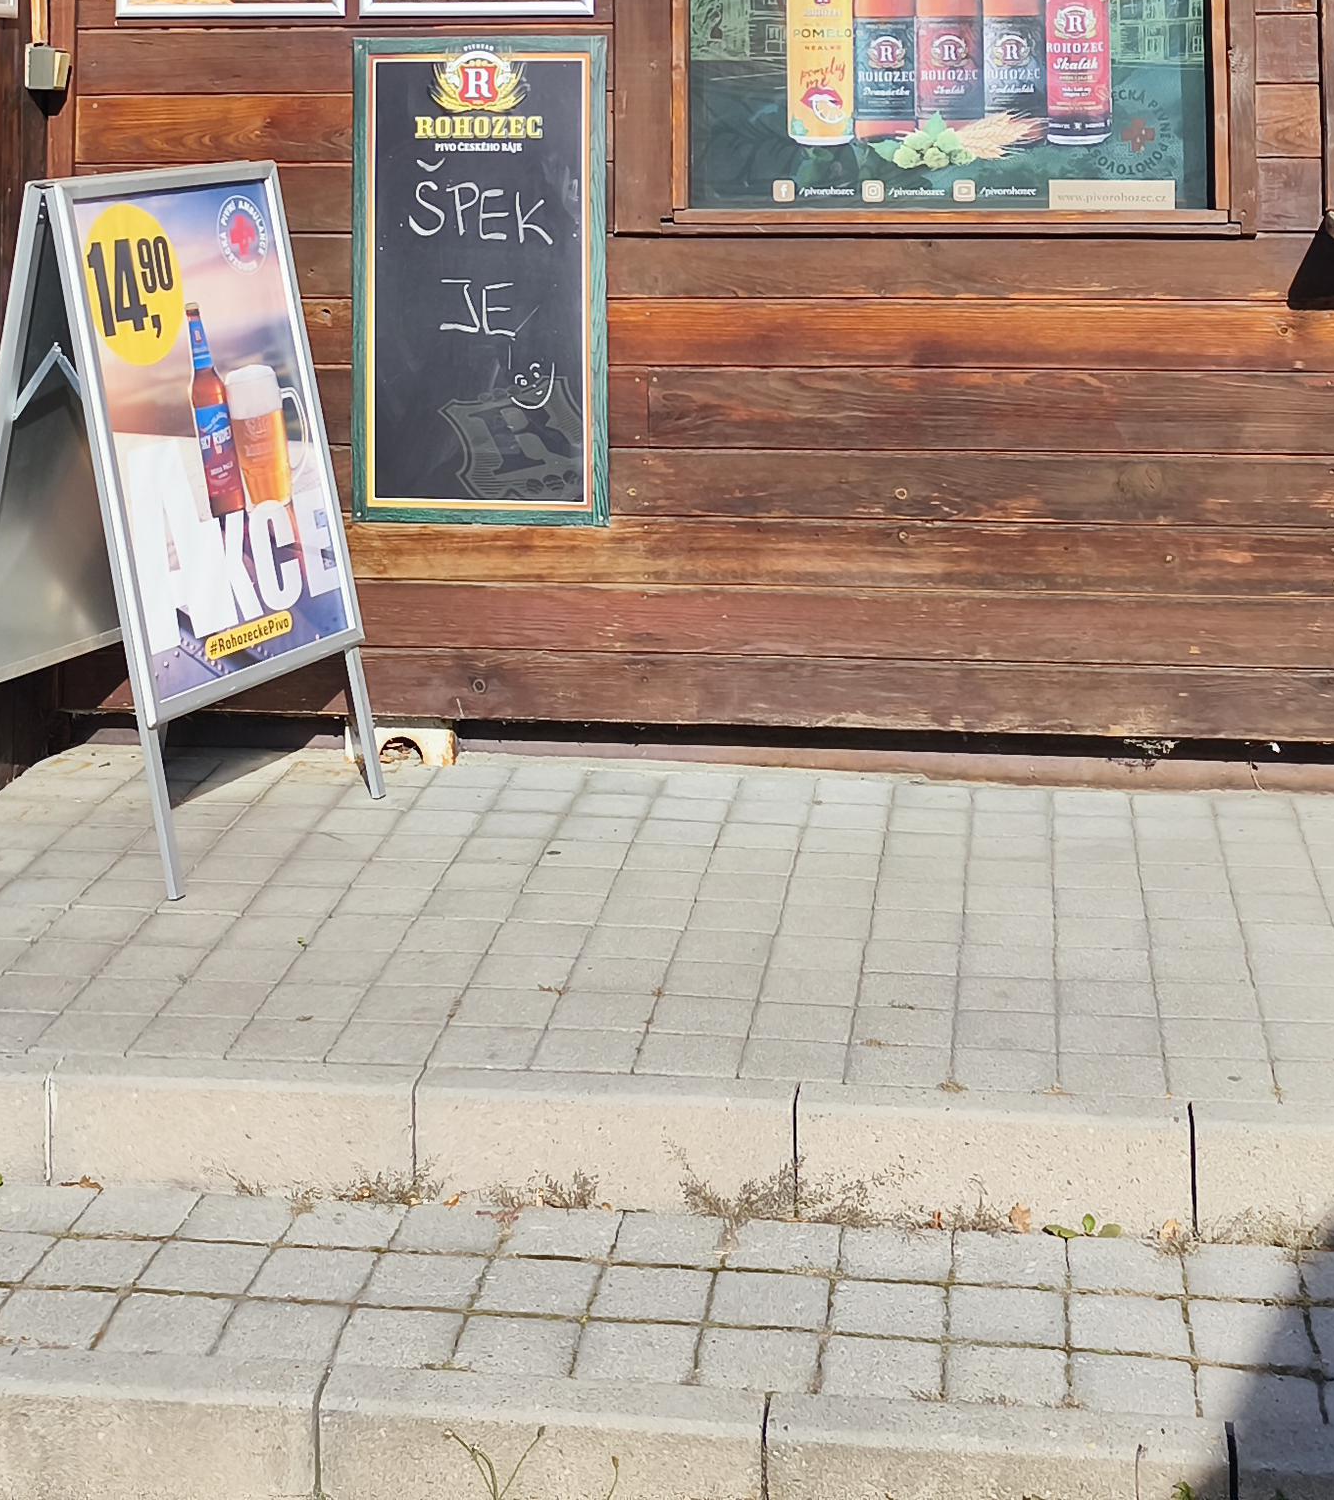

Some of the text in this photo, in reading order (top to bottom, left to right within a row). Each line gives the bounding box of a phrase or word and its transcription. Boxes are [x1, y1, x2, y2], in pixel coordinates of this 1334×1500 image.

[1046, 40, 1105, 53] ROHOZEC
[414, 115, 544, 140] ROHOZEC
[434, 141, 523, 154] PIVO ČESKÉHO RÁJE
[408, 156, 555, 245] ŠPEK
[1057, 191, 1167, 204] www.pivorohozec.cz
[438, 278, 516, 336] JE
[126, 436, 342, 657] AKCE
[208, 616, 291, 657] #RohozeckePivo
